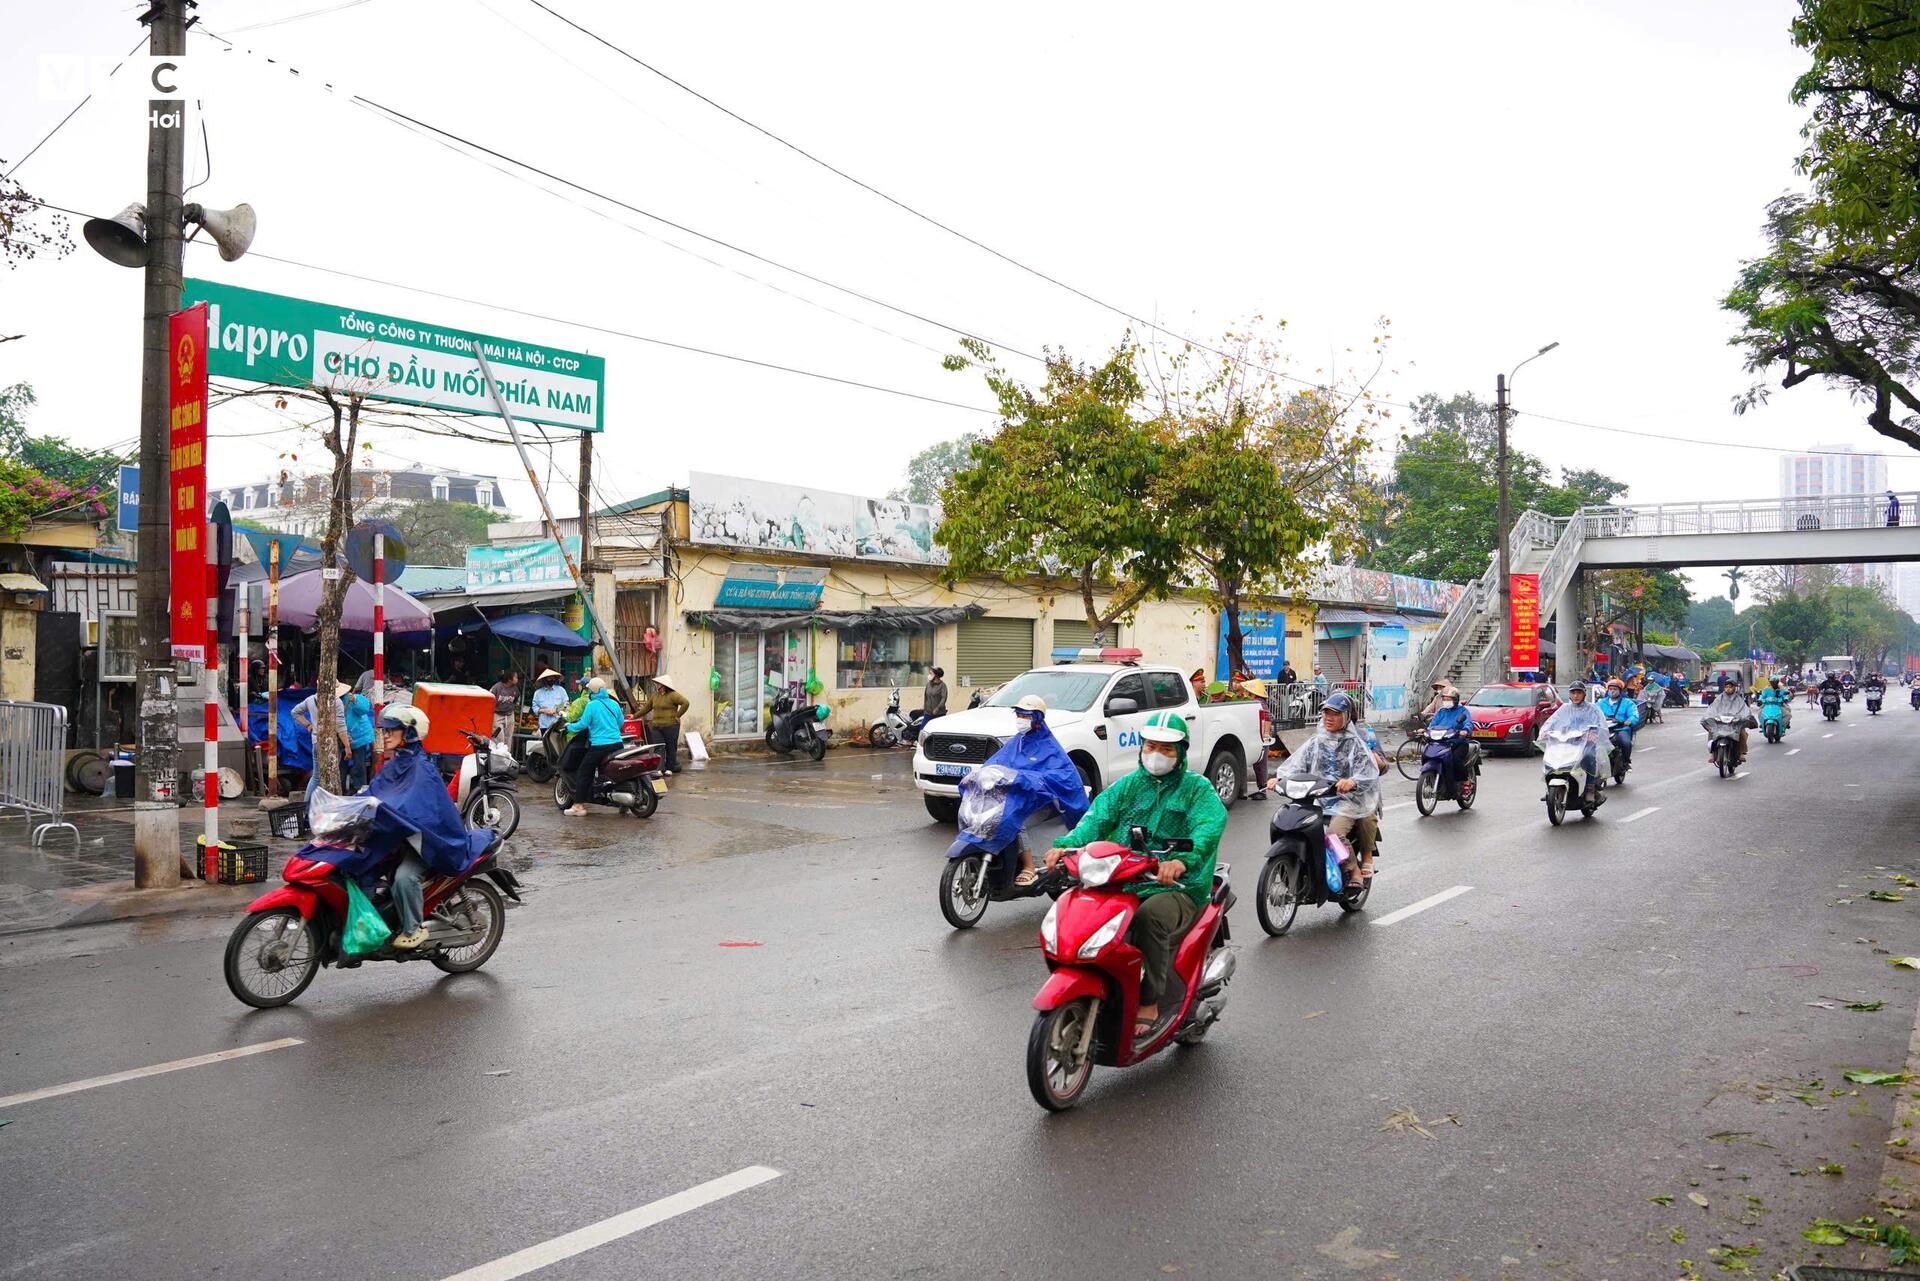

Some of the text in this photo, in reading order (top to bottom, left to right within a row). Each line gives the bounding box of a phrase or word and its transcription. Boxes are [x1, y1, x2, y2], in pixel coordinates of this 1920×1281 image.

[195, 300, 308, 366] Hapro
[339, 311, 375, 333] TỔNG
[378, 319, 416, 341] CÔNG
[418, 330, 433, 344] TY
[434, 333, 473, 352] THƯƠN
[484, 343, 505, 361] MẠI
[507, 345, 523, 360] HÀ
[525, 350, 545, 367] NỘI
[552, 356, 580, 372] CTCP
[323, 351, 381, 385] CHỢ
[387, 354, 437, 389] ĐẦU
[443, 367, 486, 397] MỐI
[547, 389, 592, 415] NAM
